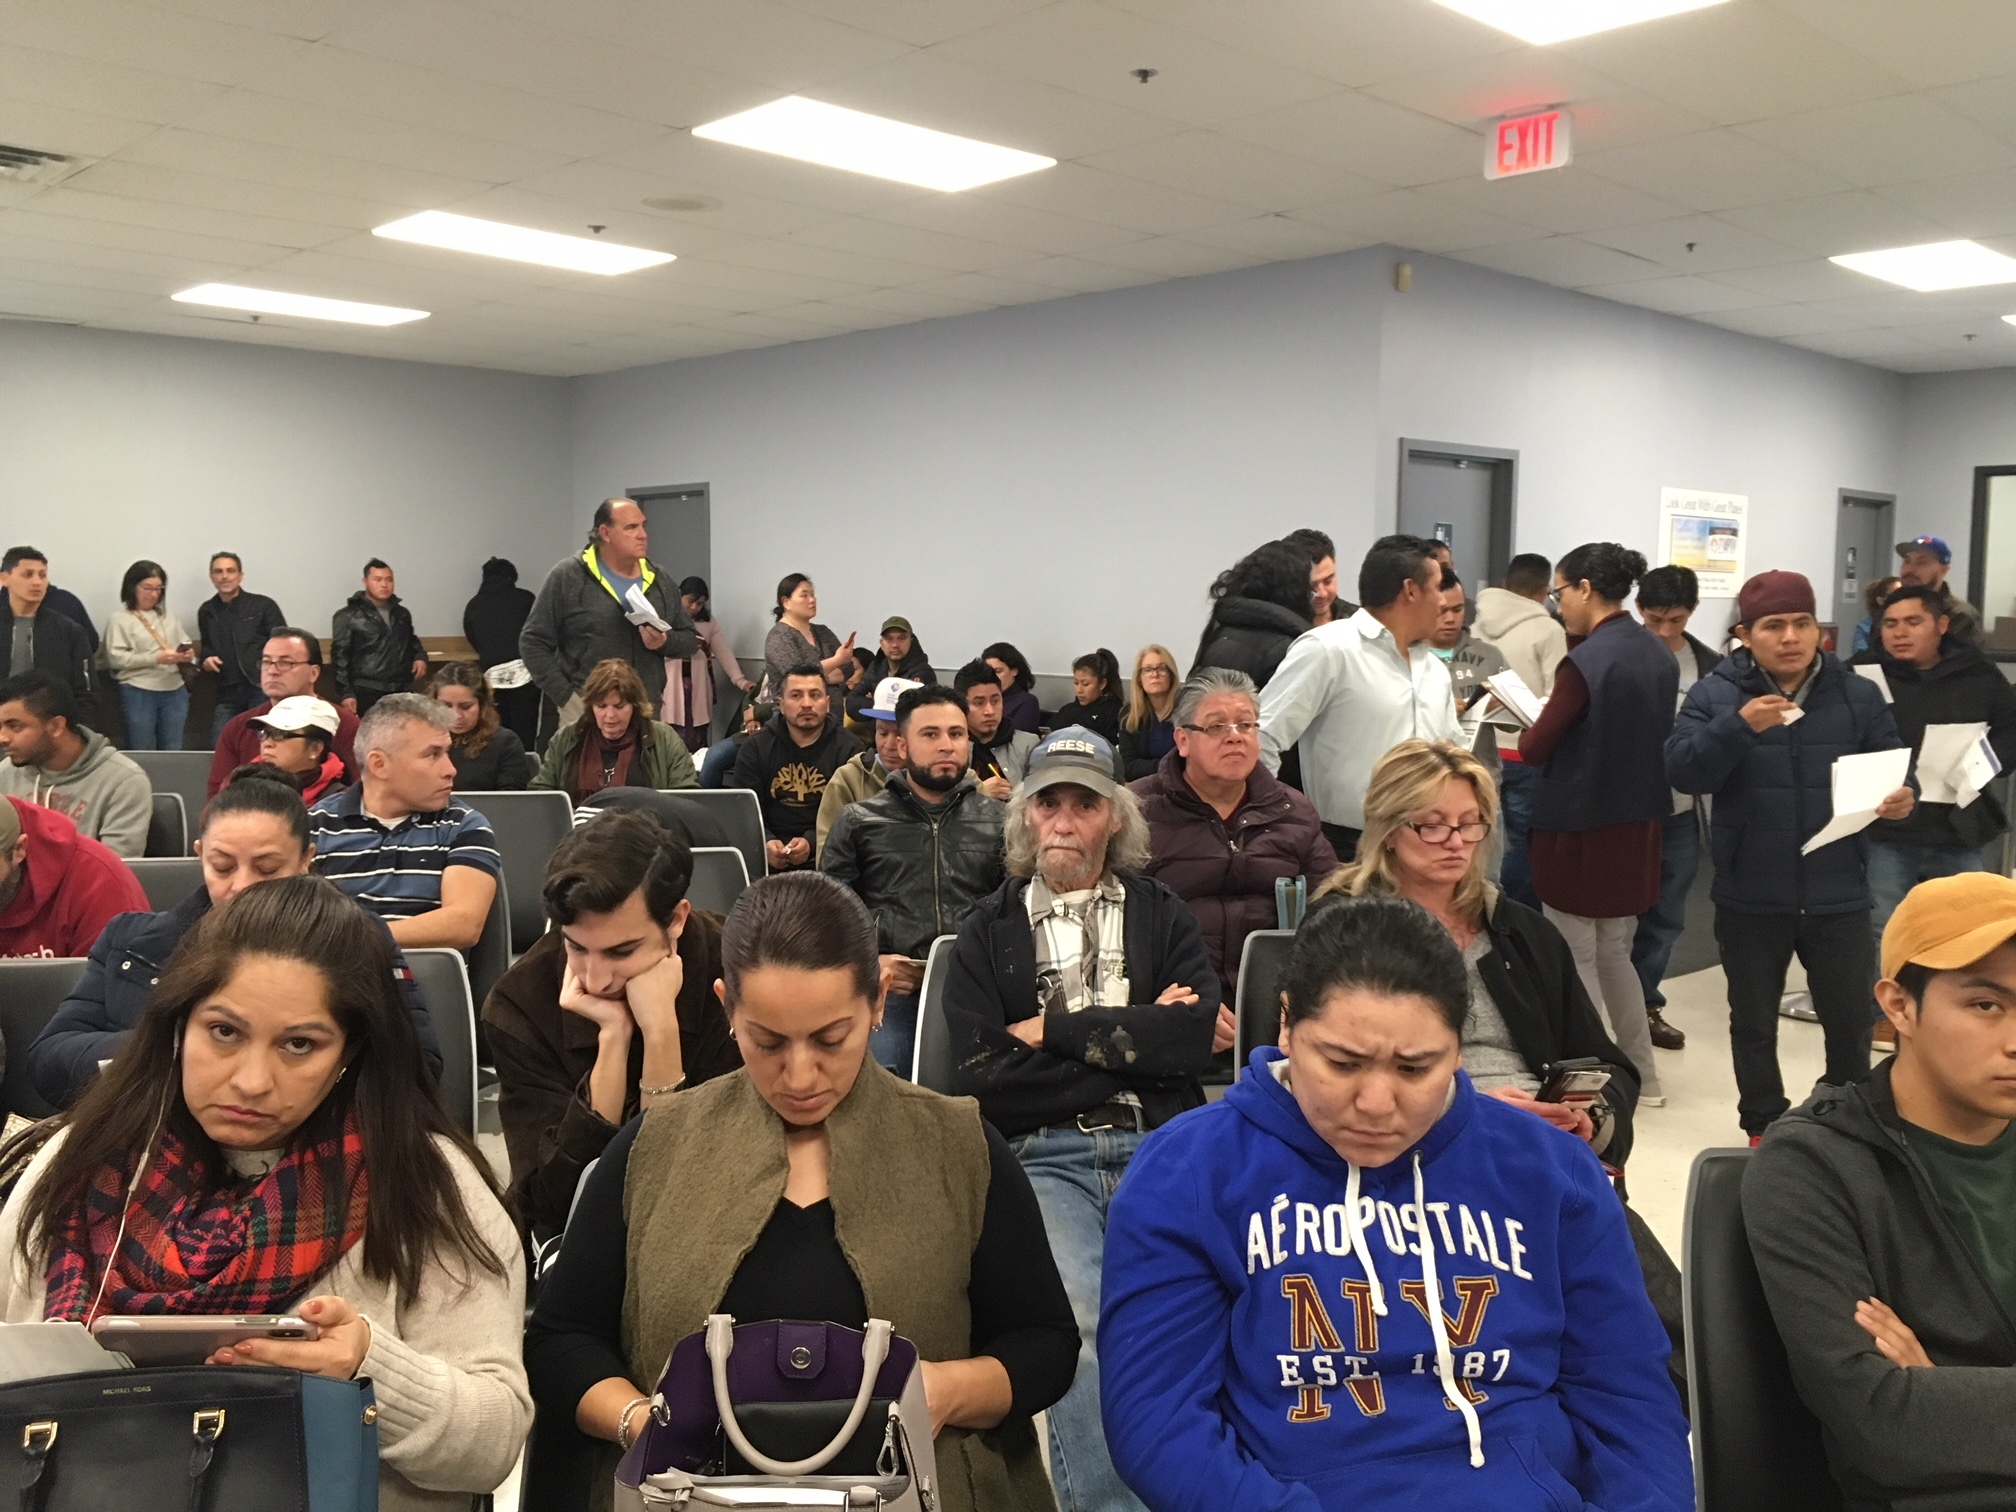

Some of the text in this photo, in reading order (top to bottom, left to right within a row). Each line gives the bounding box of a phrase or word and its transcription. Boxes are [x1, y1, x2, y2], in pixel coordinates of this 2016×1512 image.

[1497, 111, 1559, 173] EXIT
[1456, 668, 1473, 680] 94
[1047, 739, 1095, 754] REESE
[1247, 1193, 1533, 1281] AÉROPOSTALE
[1276, 1354, 1380, 1387] EST.
[102, 1385, 152, 1395] MICHAEL KORS
